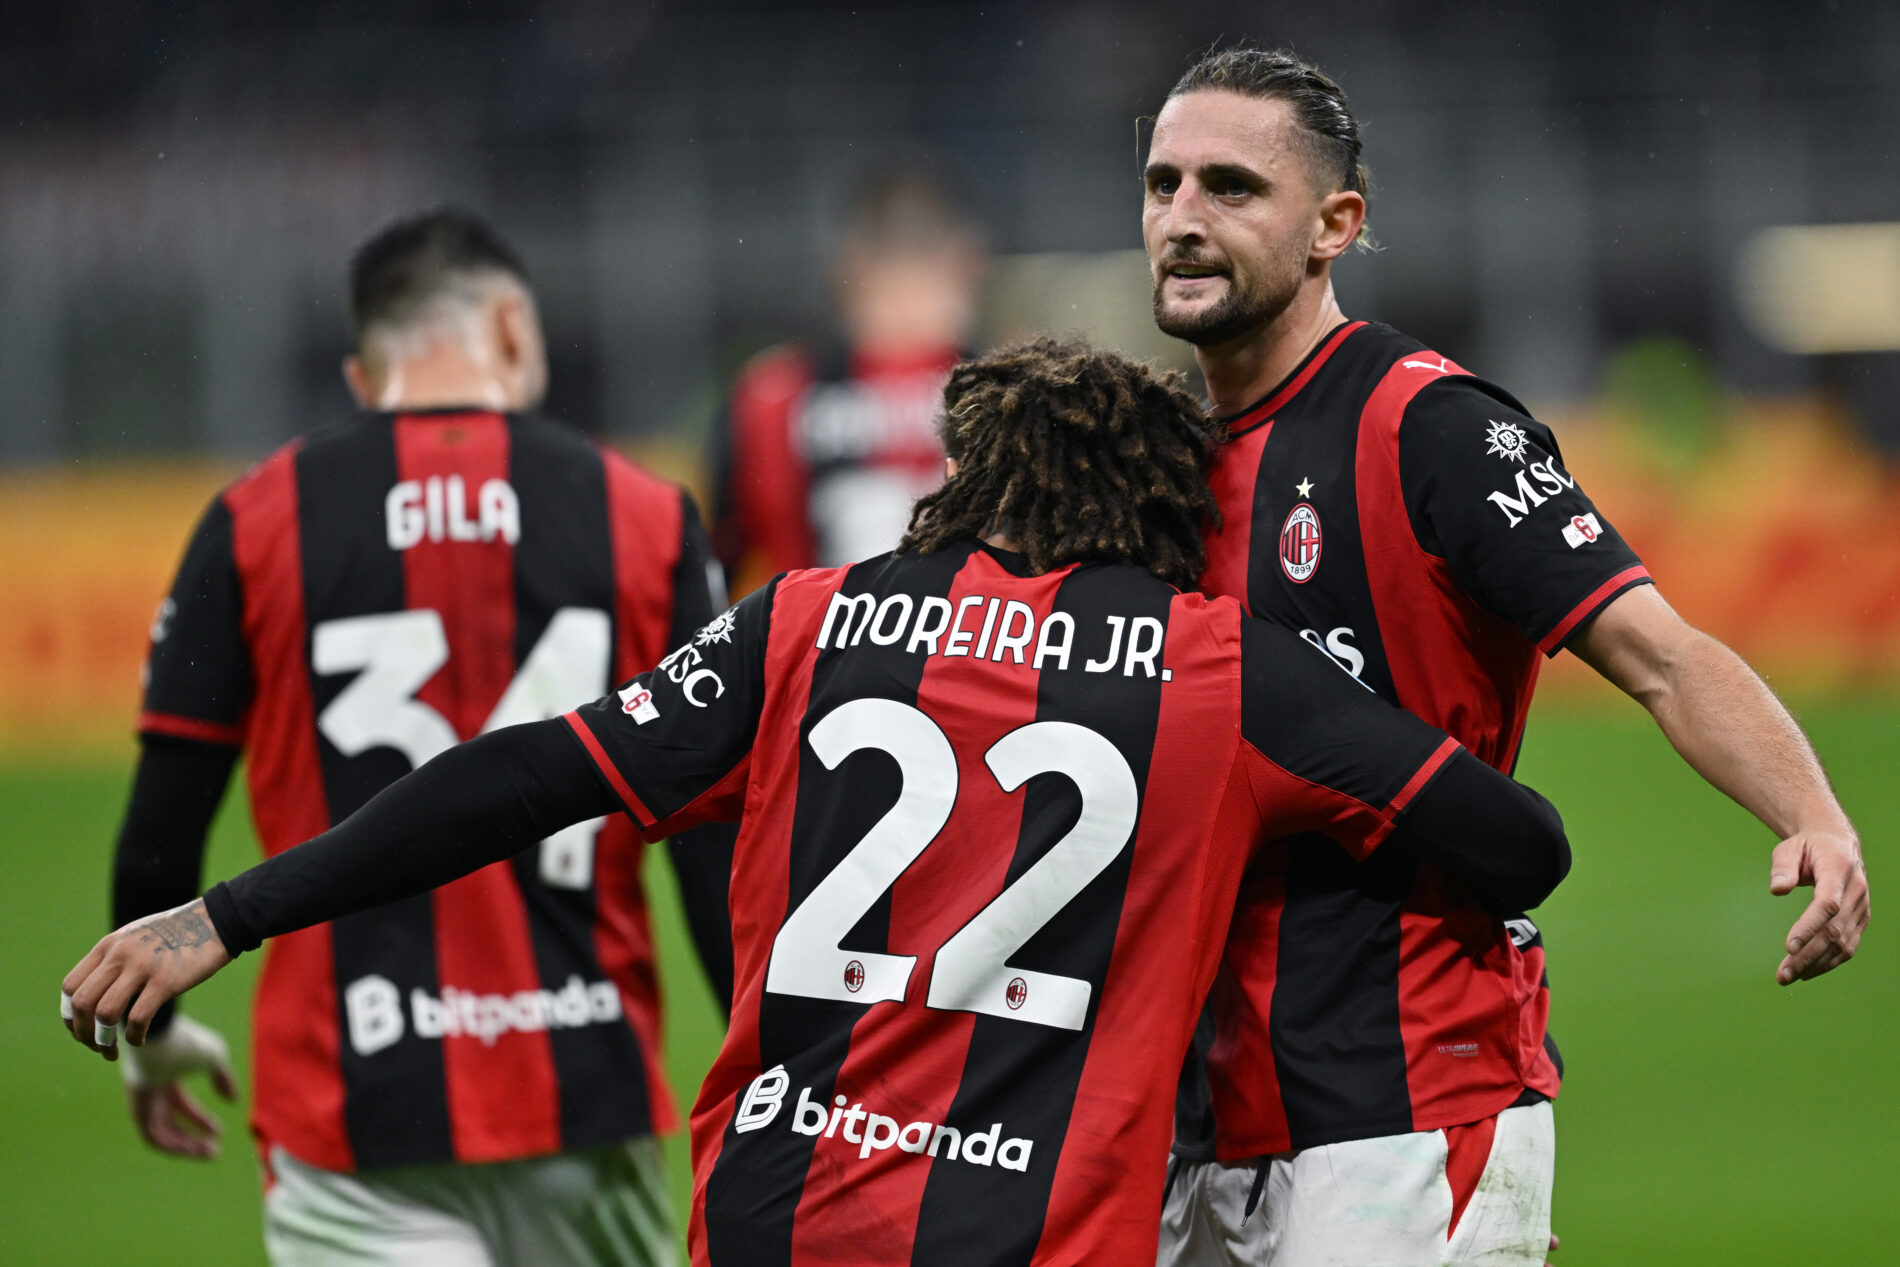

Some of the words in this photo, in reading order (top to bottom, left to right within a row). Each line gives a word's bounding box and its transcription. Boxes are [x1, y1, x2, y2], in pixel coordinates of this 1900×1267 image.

[385, 474, 520, 551] GILA
[1290, 509, 1313, 525] ACM
[1486, 455, 1574, 529] MSC
[1290, 564, 1312, 575] 1899
[816, 591, 1076, 671] MOREIRA
[1084, 615, 1173, 682] JR.
[765, 697, 1139, 1031] 22
[409, 973, 623, 1047] bitpanda
[791, 1086, 1034, 1173] bitpanda
